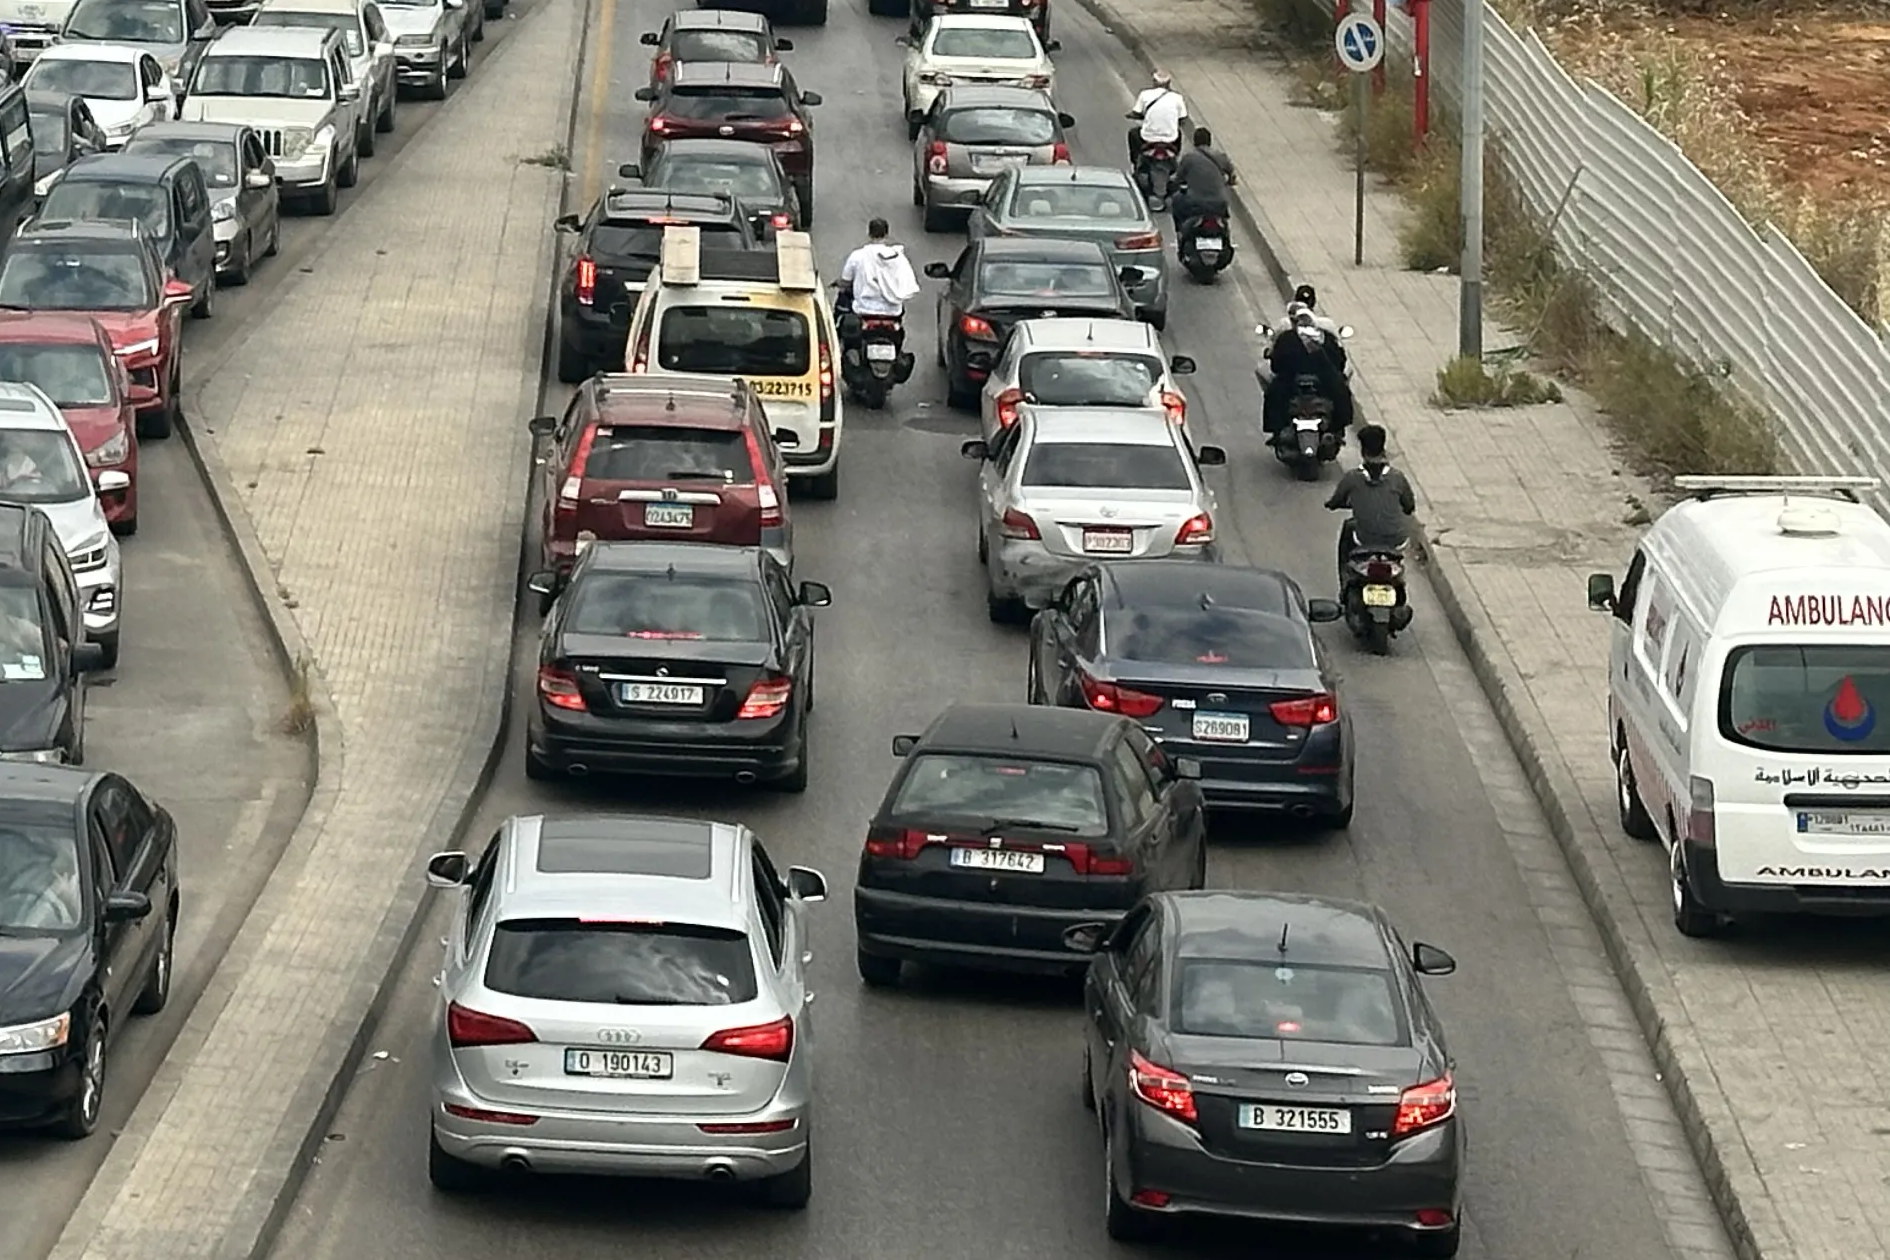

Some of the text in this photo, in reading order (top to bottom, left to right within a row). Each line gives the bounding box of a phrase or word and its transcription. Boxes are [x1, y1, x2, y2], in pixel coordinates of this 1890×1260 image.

[1768, 594, 1890, 626] AMBULAN
[603, 1052, 661, 1074] 190143
[1253, 1106, 1340, 1130] B 321555
